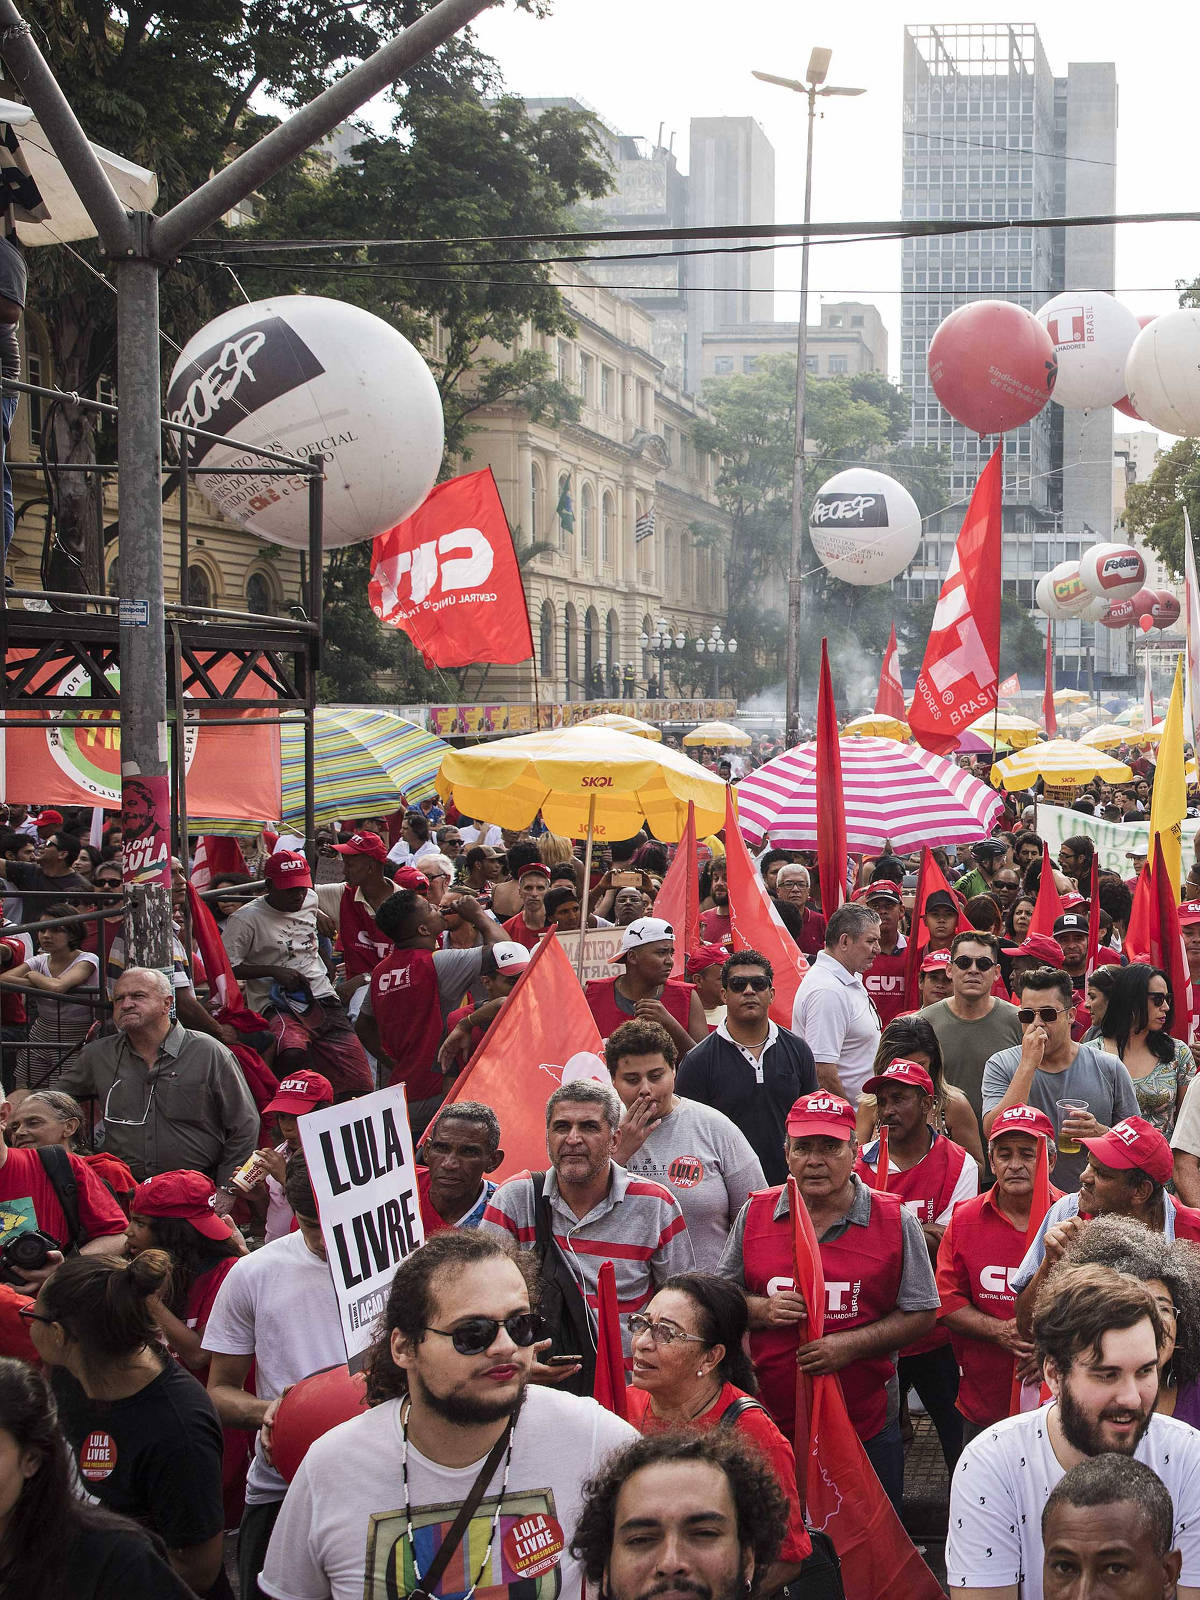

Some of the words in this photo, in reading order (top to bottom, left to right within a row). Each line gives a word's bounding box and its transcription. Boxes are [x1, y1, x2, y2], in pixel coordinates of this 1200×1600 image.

[1087, 305, 1095, 342] BRASIL
[296, 431, 359, 459] OFICIAL
[581, 776, 614, 788] SKOL
[280, 861, 301, 870] CUT
[280, 1080, 306, 1090] CUT
[807, 1099, 840, 1111] CUT
[1003, 1107, 1033, 1119] CUT
[319, 1107, 405, 1197] LULA
[670, 1164, 700, 1181] LULA
[332, 1188, 420, 1290] LIVRE
[852, 1280, 861, 1313] BRASIL
[360, 1293, 383, 1323] AÇÃO
[90, 1435, 108, 1447] LULA
[87, 1448, 110, 1460] LIVRE
[513, 1515, 546, 1541] LULA
[516, 1529, 554, 1558] LIVRE
